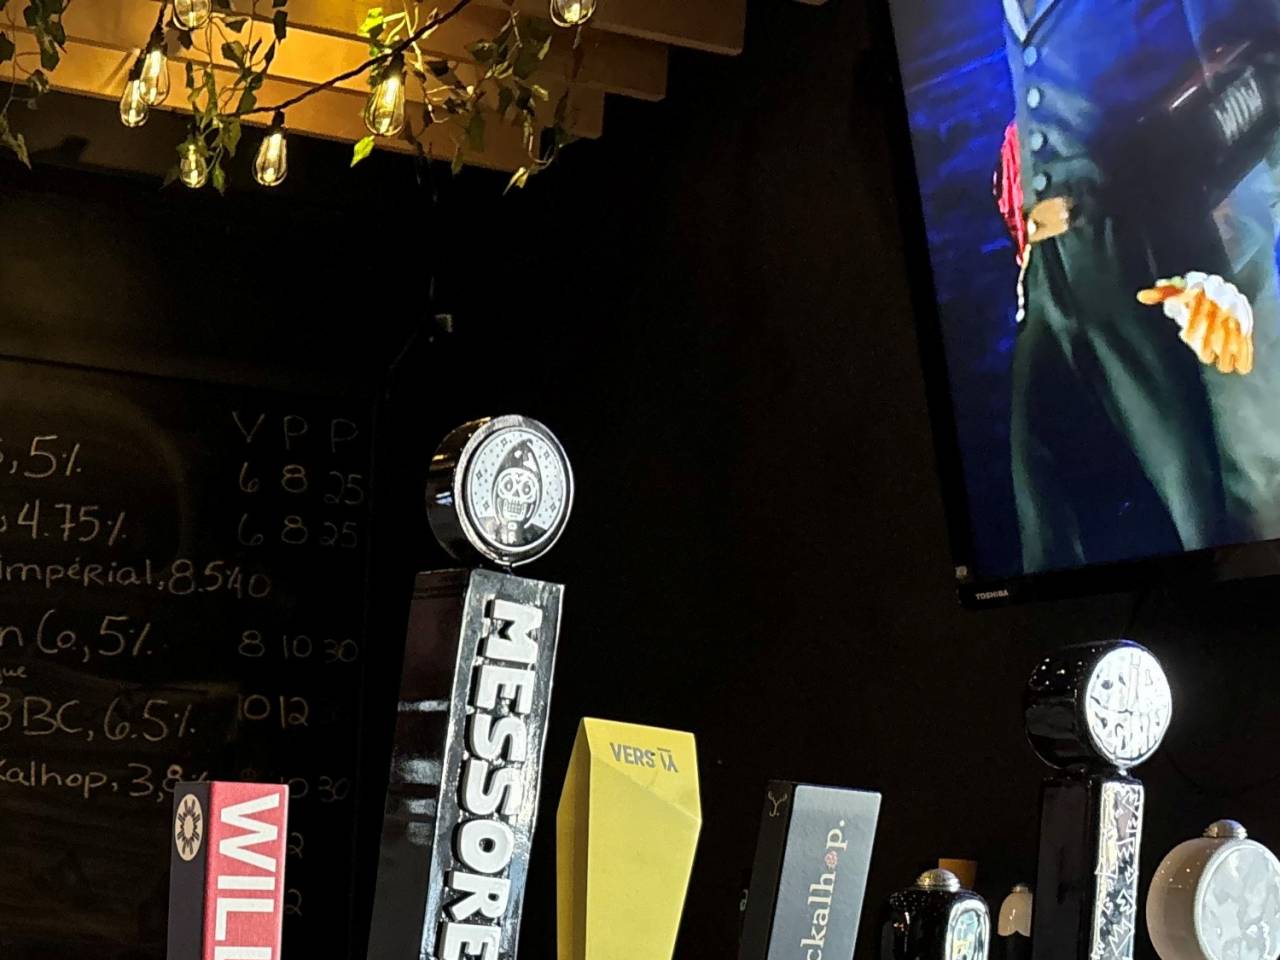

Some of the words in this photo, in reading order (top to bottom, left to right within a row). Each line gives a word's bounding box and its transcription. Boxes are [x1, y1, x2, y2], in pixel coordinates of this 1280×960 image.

[231, 410, 266, 443] V
[280, 414, 310, 450] P
[329, 417, 359, 453] P
[281, 463, 309, 494] 8
[322, 470, 365, 506] 25
[280, 514, 309, 545] 8
[319, 520, 359, 549] 25
[237, 629, 266, 658] 8
[283, 634, 314, 661] 10
[278, 694, 311, 731] 12
